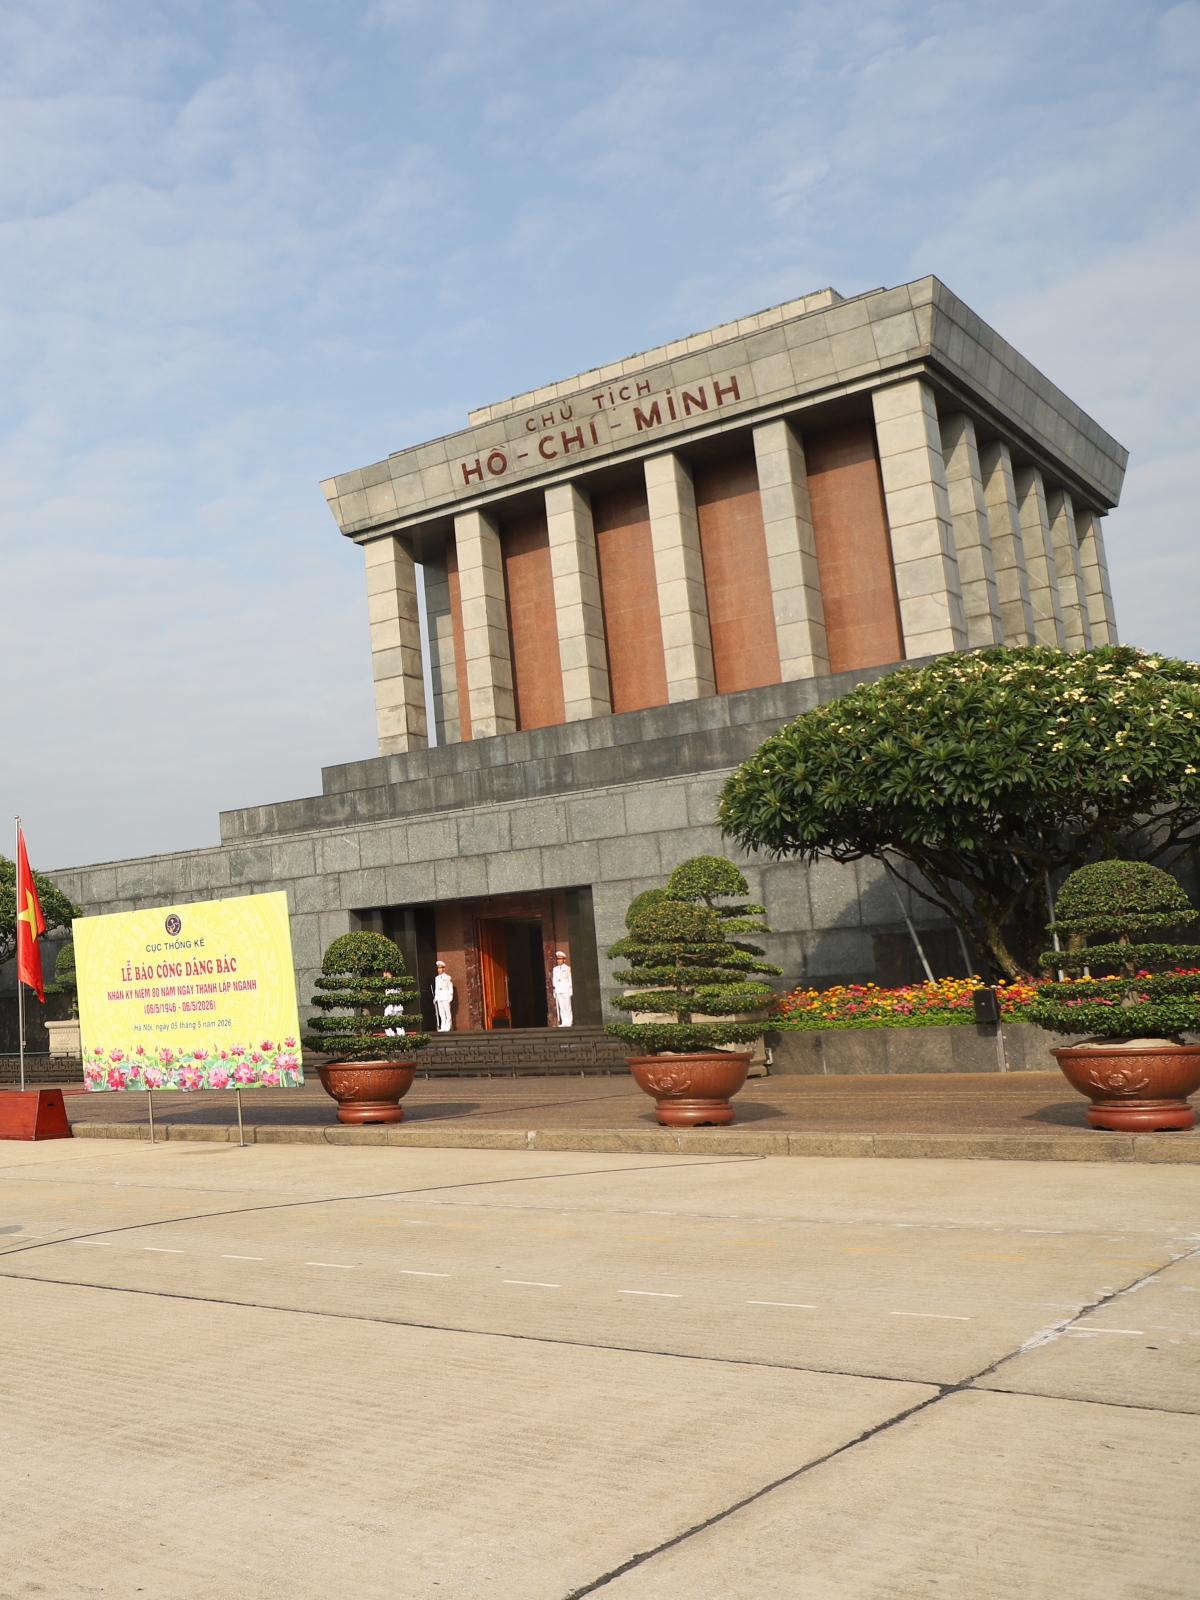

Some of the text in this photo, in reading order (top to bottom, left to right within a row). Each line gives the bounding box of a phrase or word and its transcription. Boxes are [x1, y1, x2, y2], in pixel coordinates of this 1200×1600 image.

[525, 400, 573, 432] CHỦ
[461, 444, 508, 486] HỒ
[538, 415, 599, 460] CHÍ
[145, 937, 205, 953] CỤC THỐNG KÊ
[121, 954, 237, 982] LỄ BÁO CÔNG DÂNG BÁC
[151, 987, 160, 998] 80
[171, 1022, 178, 1030] 05
[217, 1018, 232, 1027] 2026
